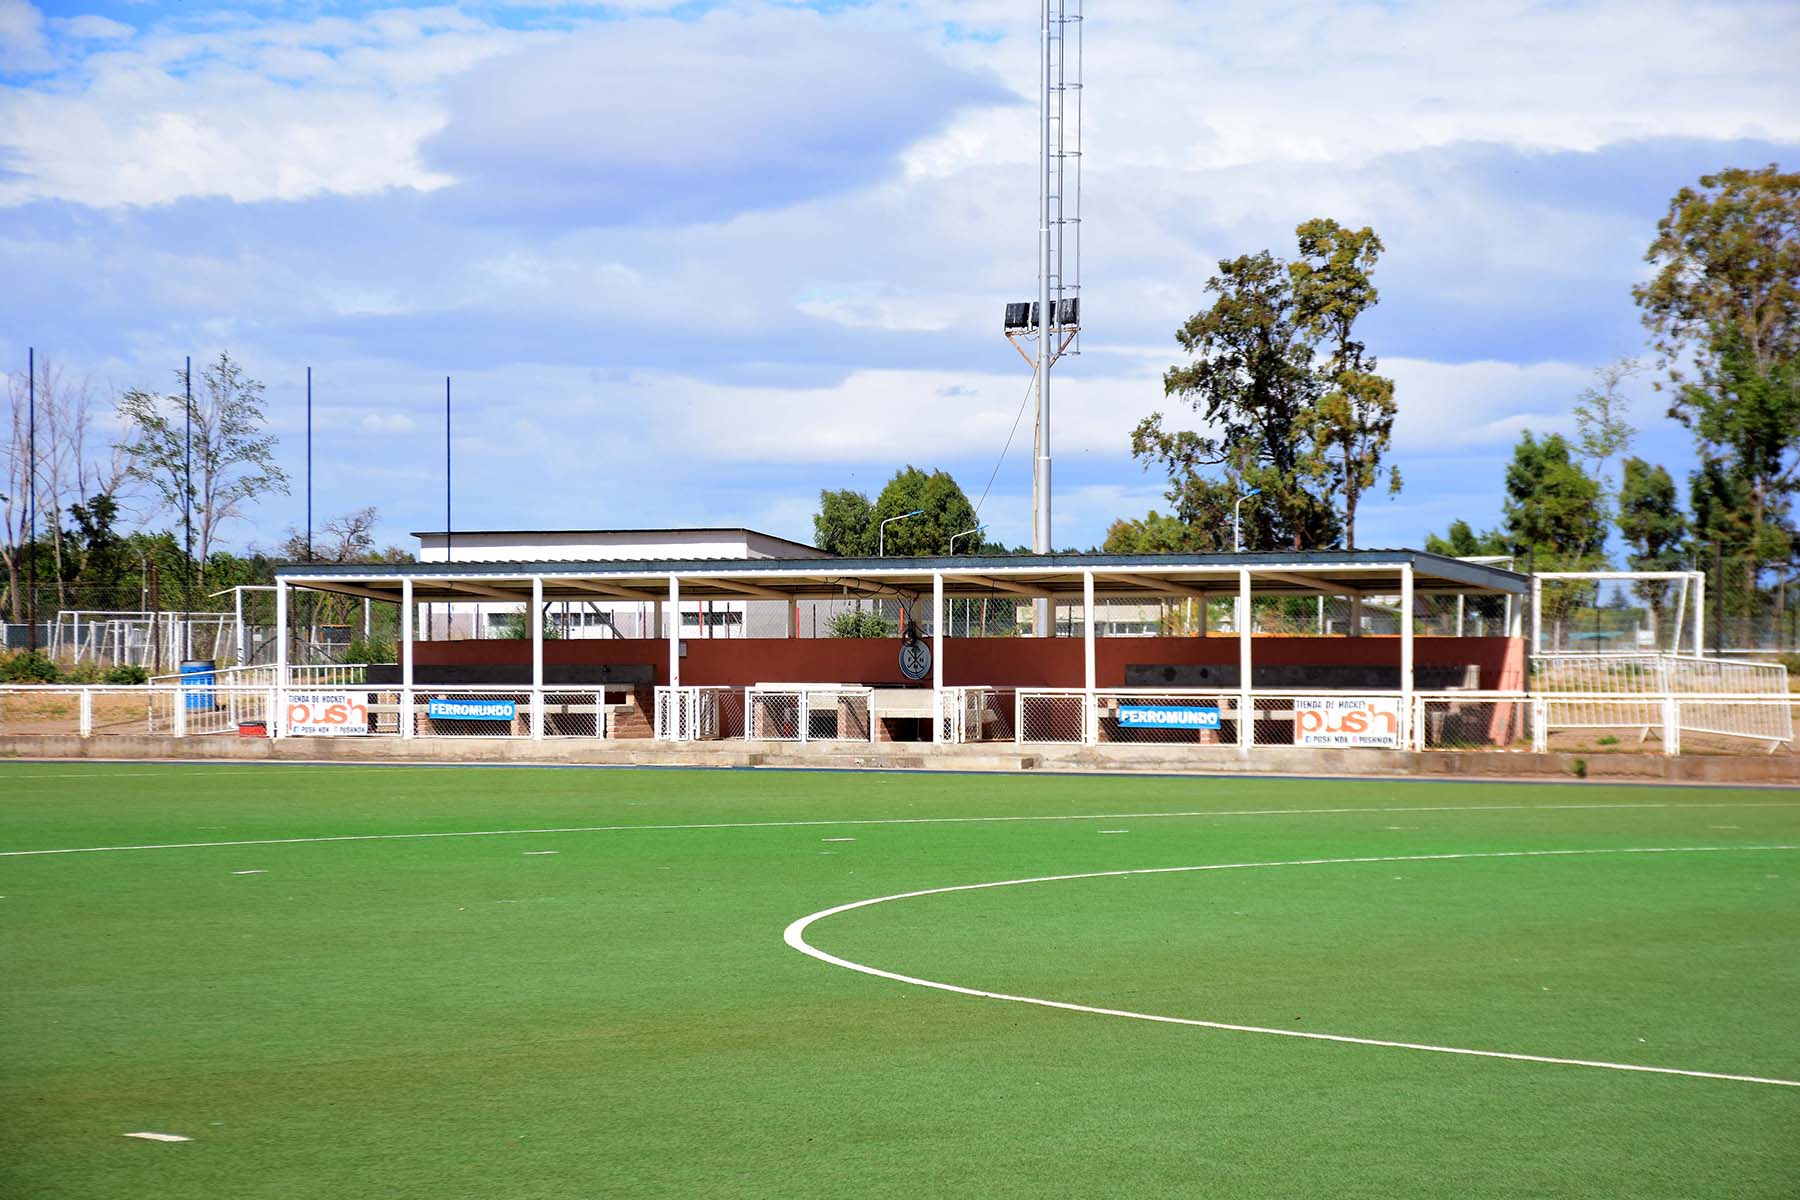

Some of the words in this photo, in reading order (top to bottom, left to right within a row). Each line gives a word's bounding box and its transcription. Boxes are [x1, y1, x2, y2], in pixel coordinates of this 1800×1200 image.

[288, 695, 309, 703] TIENDA
[312, 695, 319, 703] DE
[322, 695, 346, 704] HOCKEY
[1296, 700, 1322, 709] TIENDA
[1326, 700, 1335, 709] DE
[1338, 700, 1366, 709] HOCKEY
[287, 698, 368, 730] push
[430, 703, 514, 717] FERROMUNDO
[1120, 710, 1218, 725] FERROMUNDO
[1296, 704, 1396, 740] push
